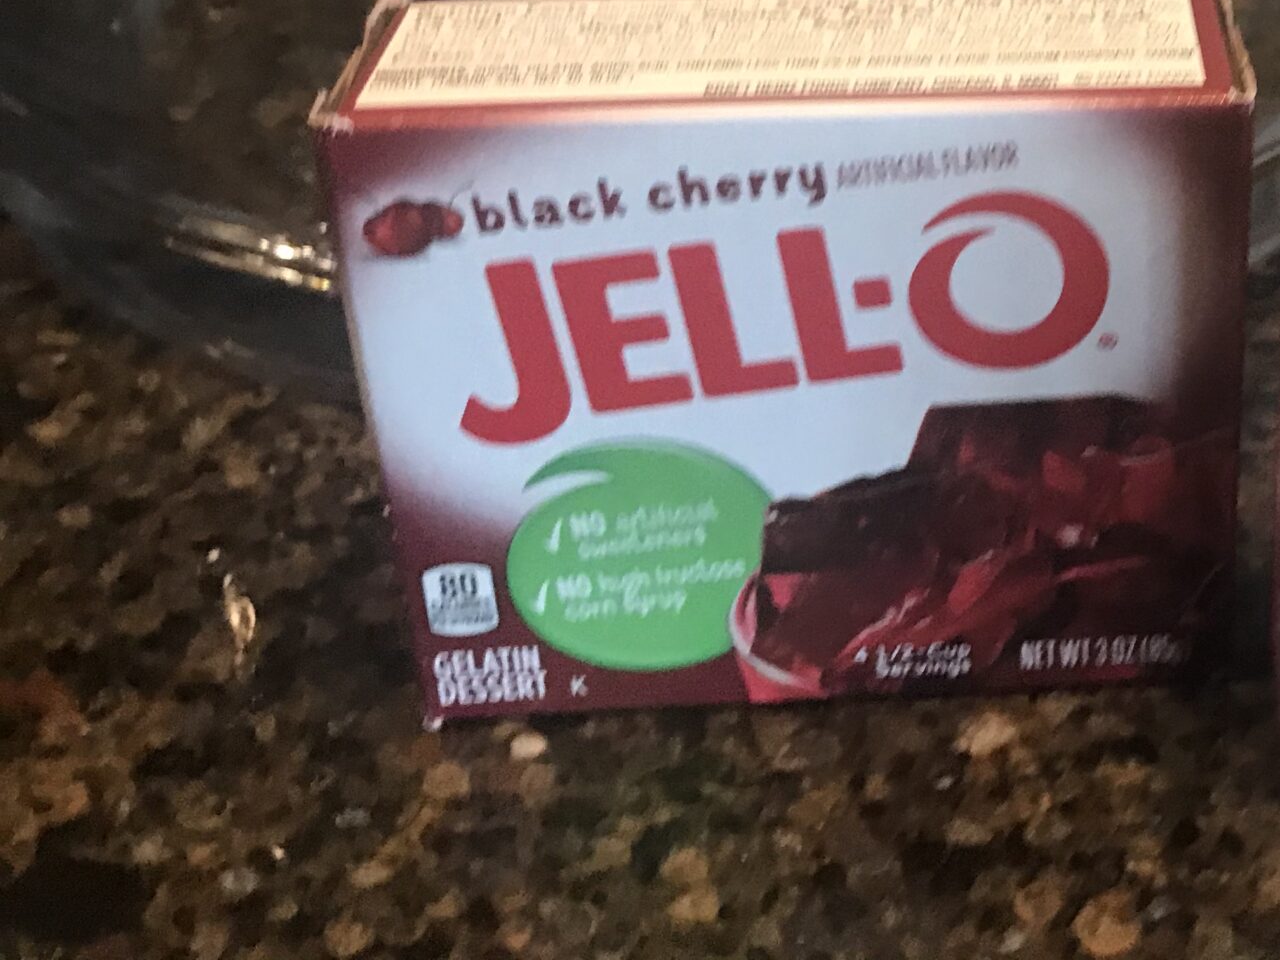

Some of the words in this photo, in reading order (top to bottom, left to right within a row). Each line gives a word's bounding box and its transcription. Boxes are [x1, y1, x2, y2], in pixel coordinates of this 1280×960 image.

[471, 176, 627, 235] black
[647, 160, 828, 211] cherry
[940, 139, 1020, 178] FLAVOR
[459, 187, 1110, 443] JELL-O
[433, 645, 542, 679] GELATIN
[1020, 638, 1055, 670] NET
[437, 669, 547, 707] DESSERT
